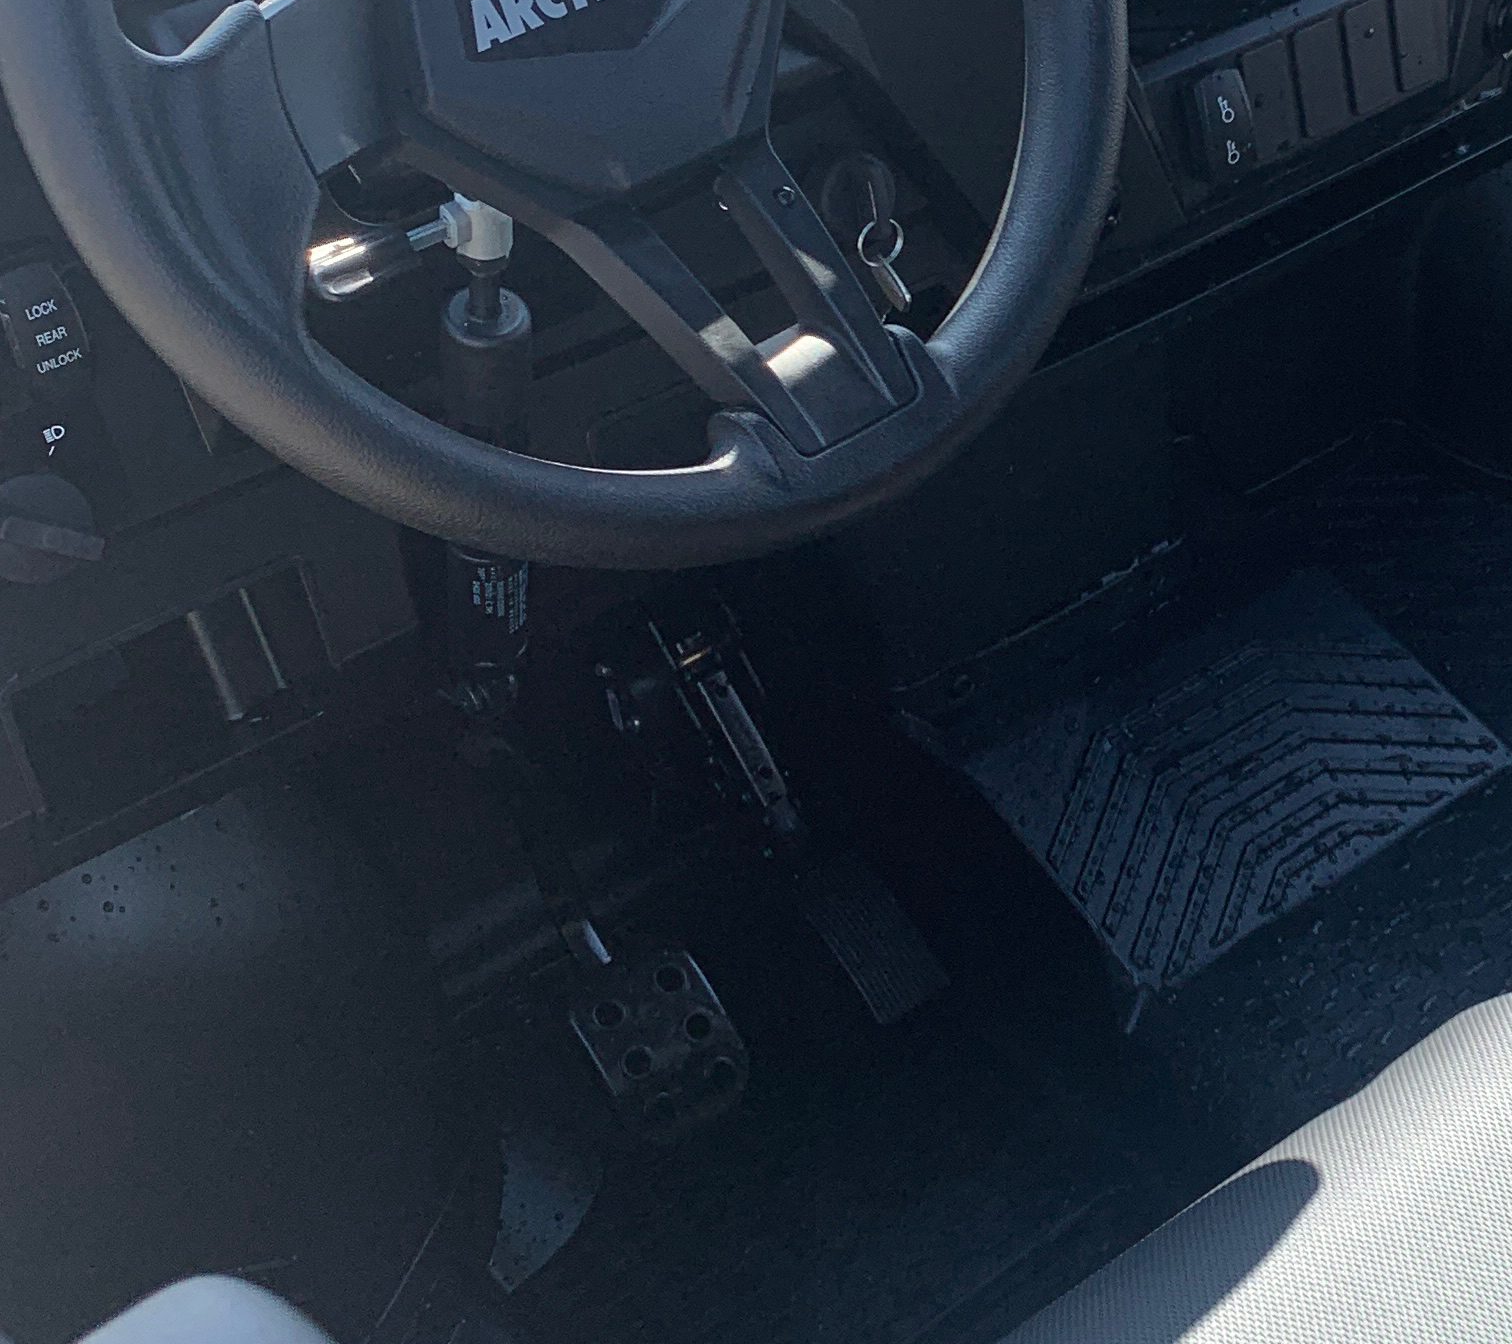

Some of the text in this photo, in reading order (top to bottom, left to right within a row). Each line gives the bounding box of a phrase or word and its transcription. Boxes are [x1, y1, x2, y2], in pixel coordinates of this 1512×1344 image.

[25, 299, 58, 321] LOCK
[35, 326, 68, 346] REAR
[36, 348, 83, 374] UNLOCK
